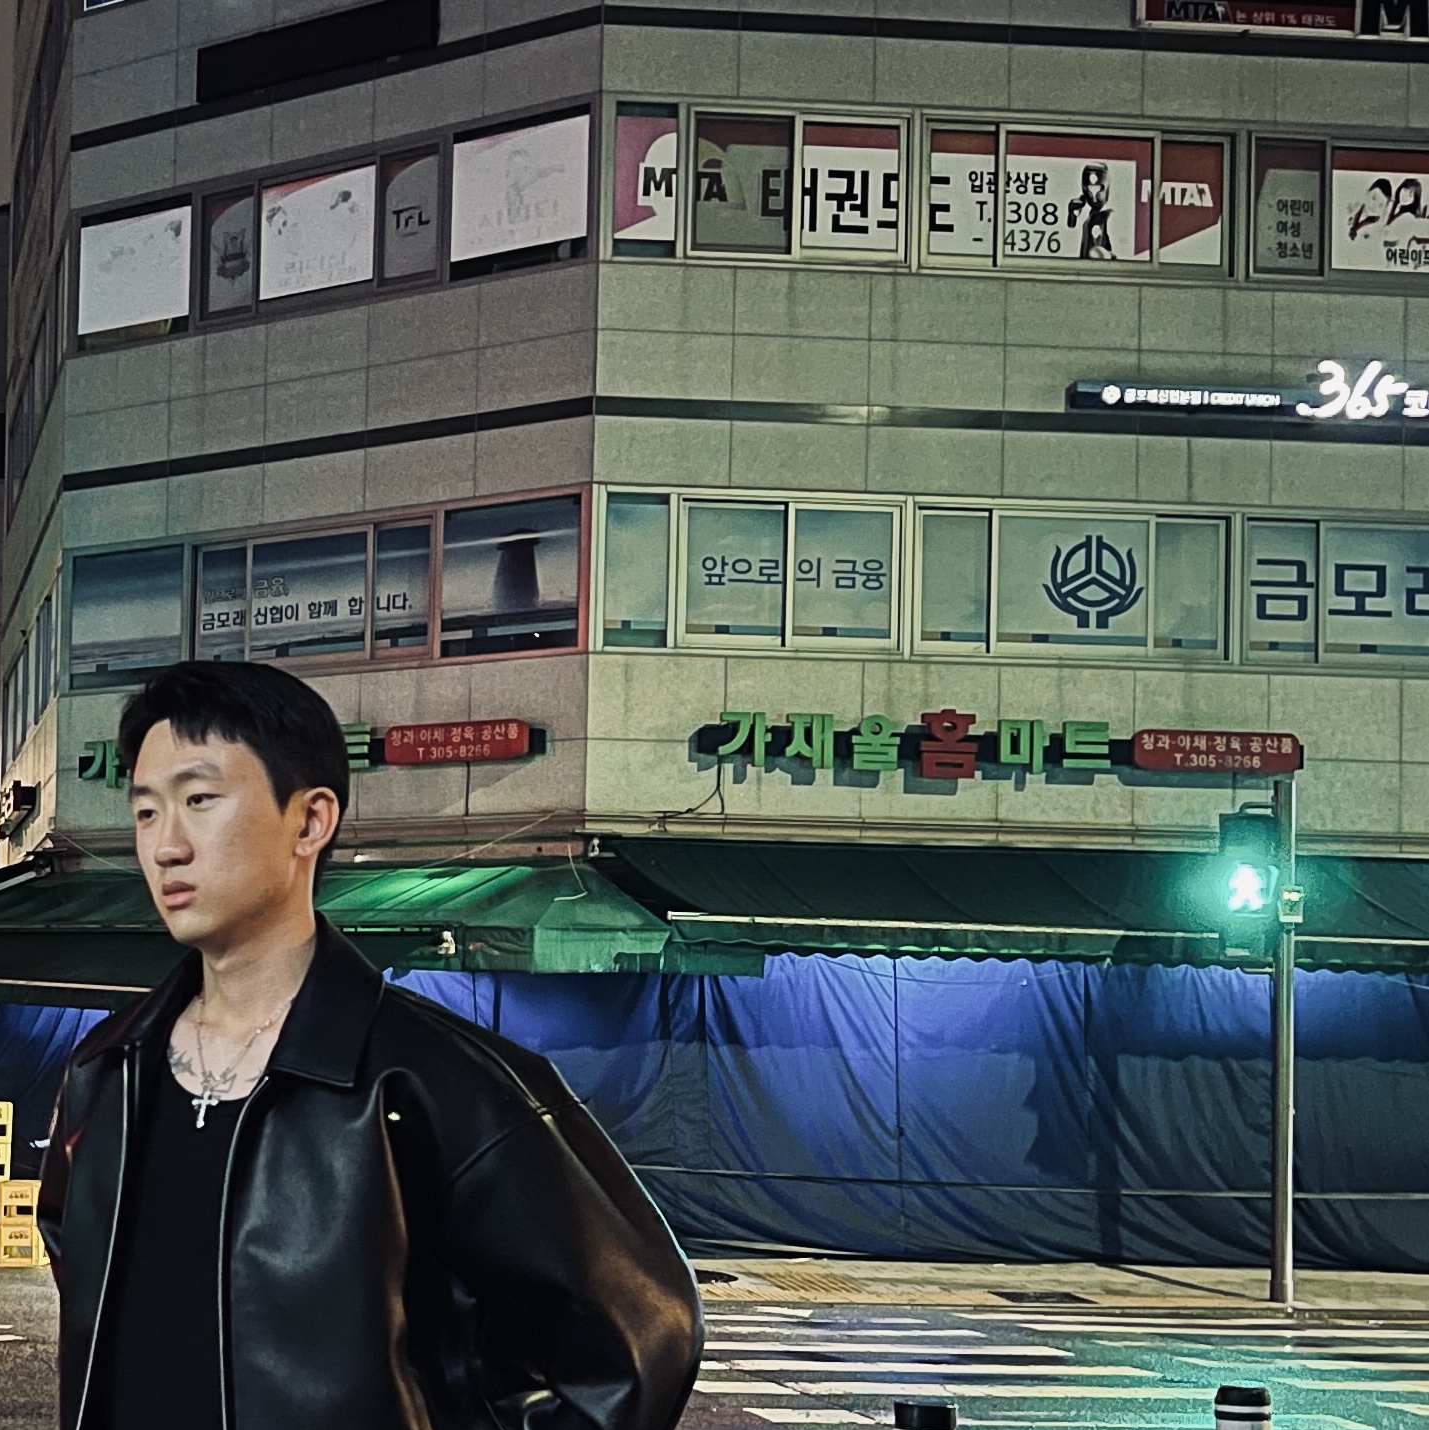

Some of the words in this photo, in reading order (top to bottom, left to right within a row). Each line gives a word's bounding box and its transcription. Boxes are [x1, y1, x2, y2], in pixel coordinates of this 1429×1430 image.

[1276, 199, 1315, 217] 어린이
[1276, 220, 1302, 238] 여성
[1276, 241, 1314, 259] 청소년
[832, 558, 887, 590] 금융
